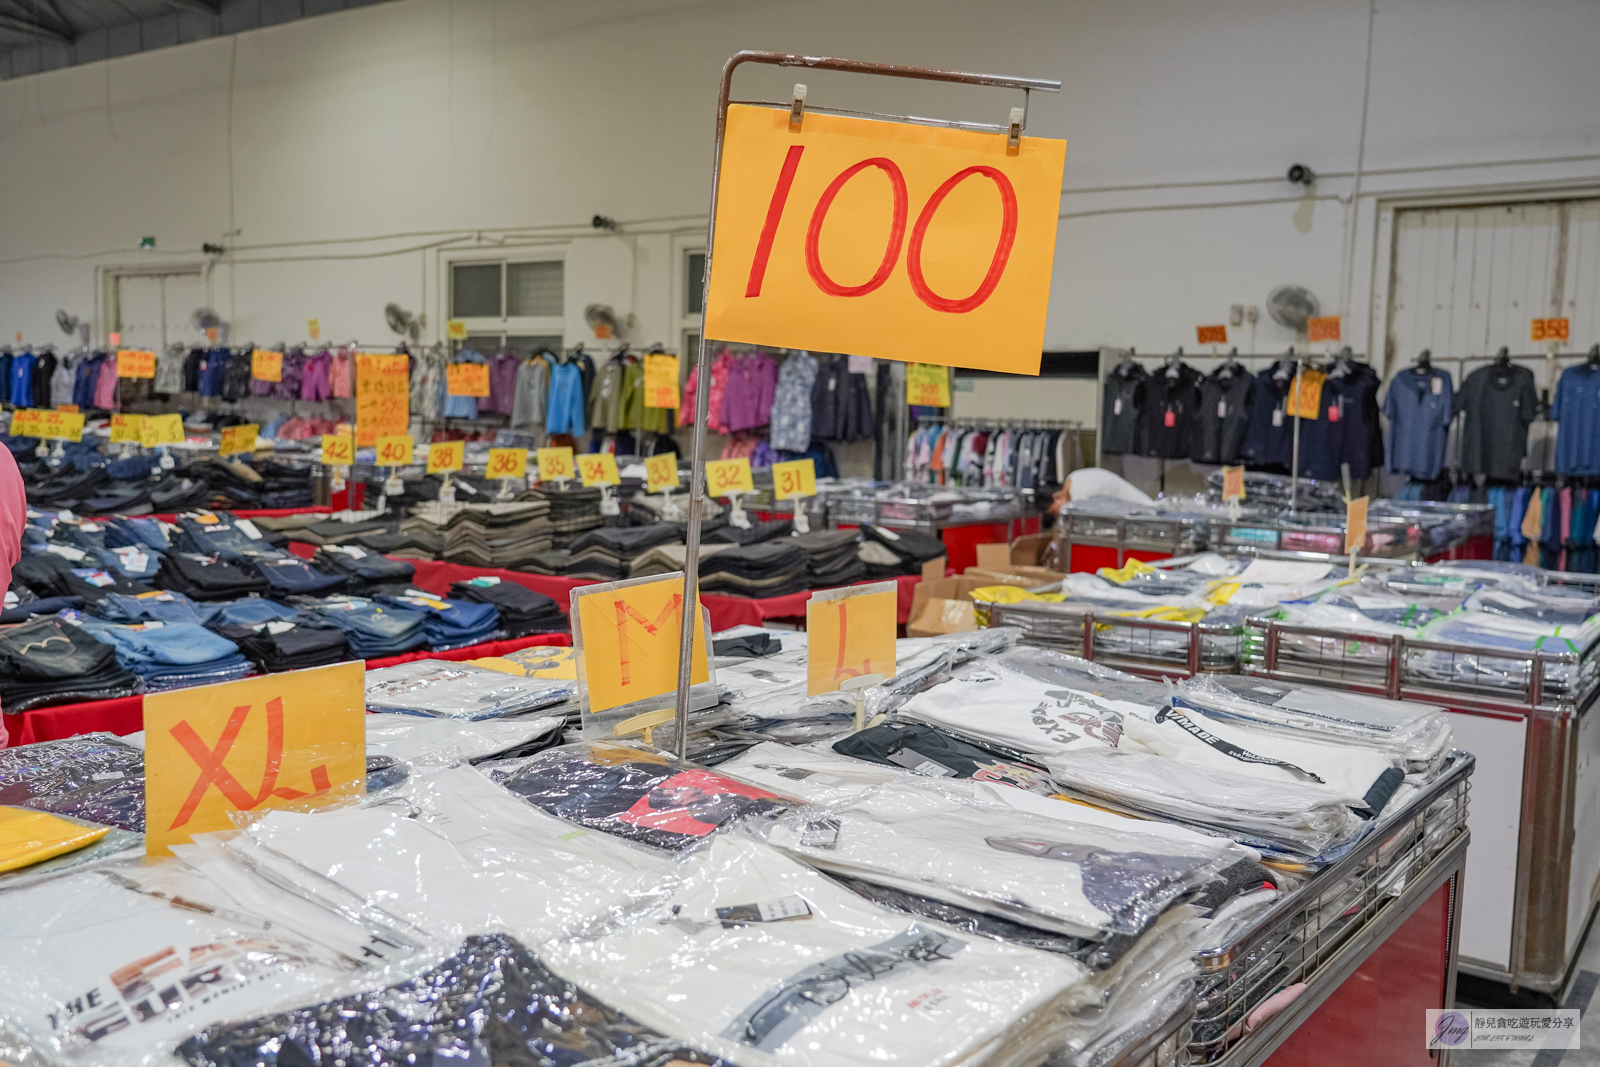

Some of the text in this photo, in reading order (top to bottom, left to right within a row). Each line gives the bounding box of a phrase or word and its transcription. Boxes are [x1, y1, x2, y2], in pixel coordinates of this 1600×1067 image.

[745, 145, 1018, 313] 100
[325, 442, 349, 461] 42
[380, 443, 405, 461] 40
[432, 447, 453, 468] 38
[492, 452, 518, 473] 36
[545, 456, 566, 475] 35
[584, 462, 607, 481] 34
[650, 465, 671, 485] 33
[715, 465, 742, 488] 32
[781, 469, 802, 493] 31
[168, 696, 332, 831] XL
